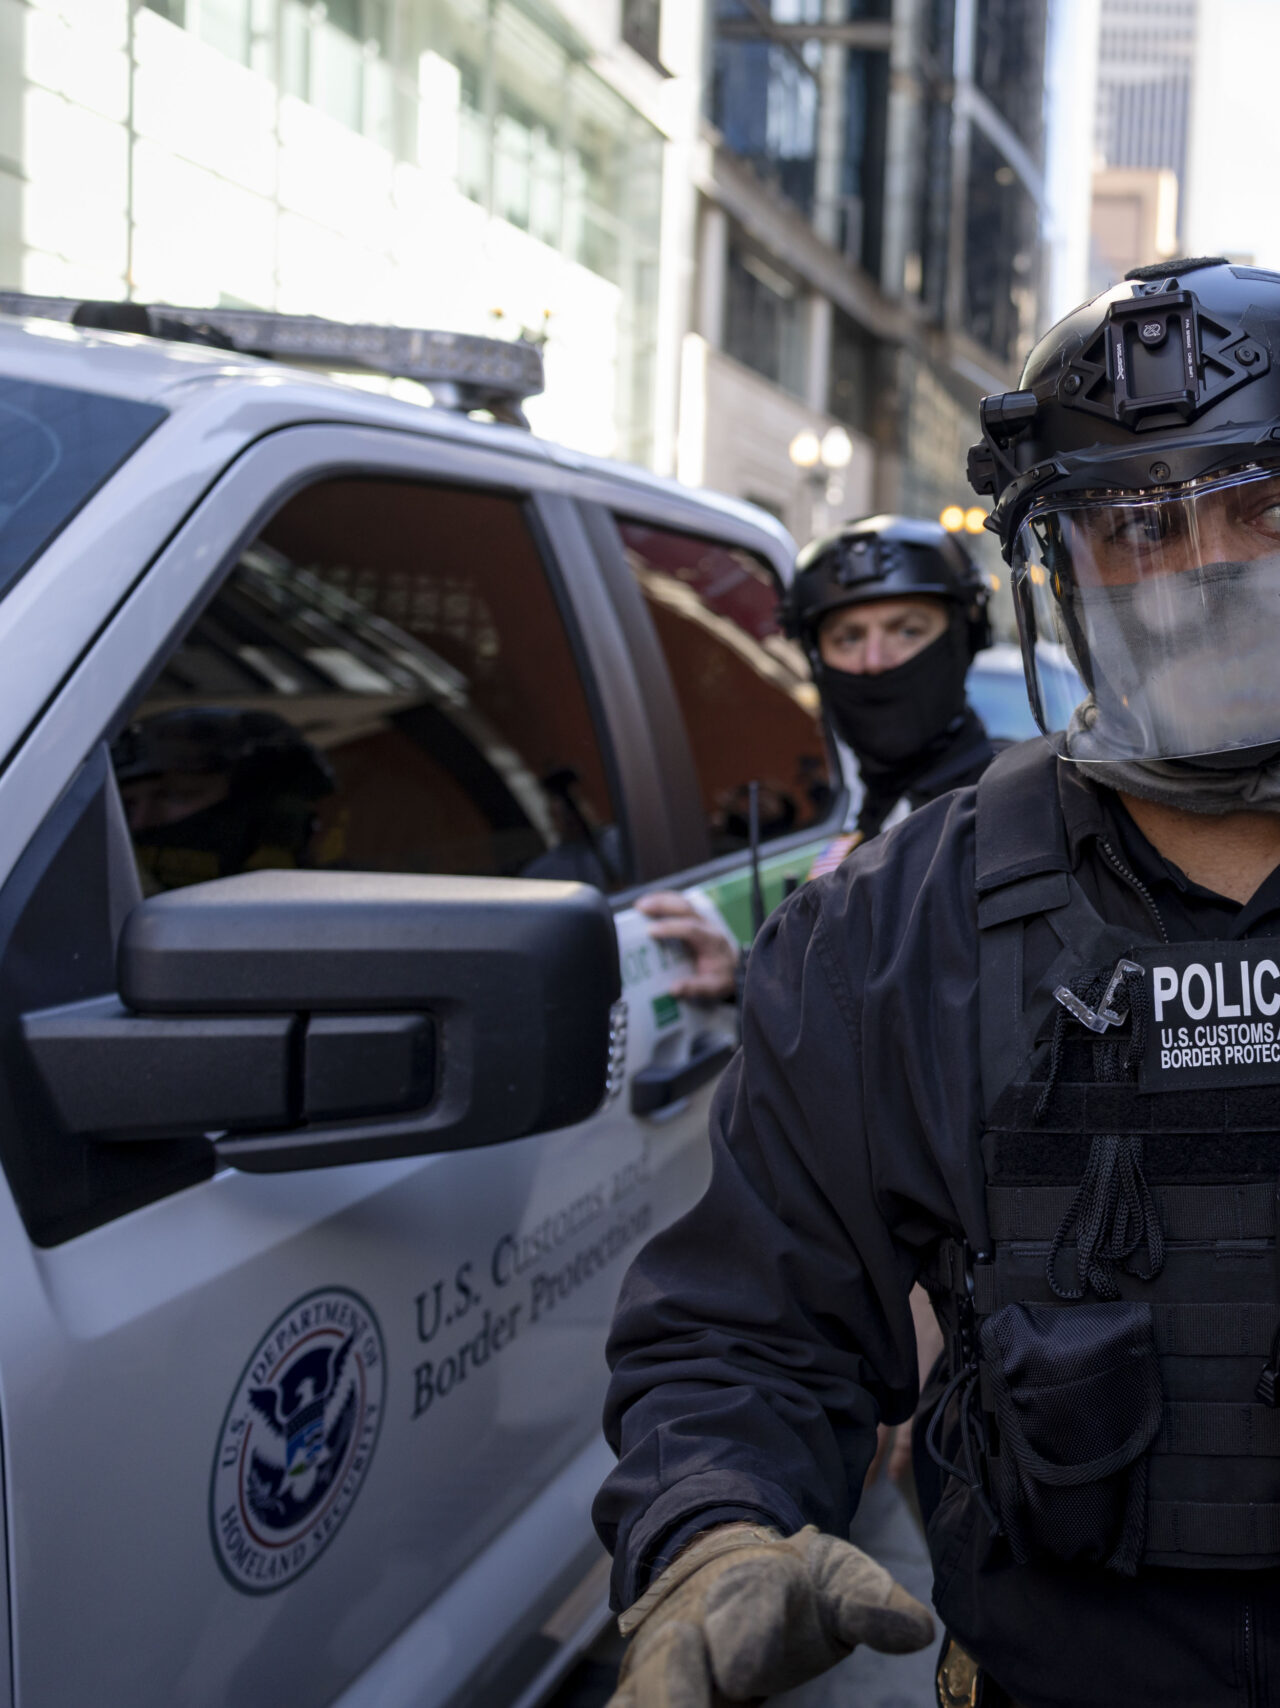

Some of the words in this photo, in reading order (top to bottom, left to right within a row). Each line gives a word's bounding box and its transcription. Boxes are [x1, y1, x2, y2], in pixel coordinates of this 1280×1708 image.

[1161, 1027, 1193, 1048] U.S.
[1194, 1022, 1274, 1047] CUSTOMS
[1161, 1046, 1222, 1069] BORDER
[414, 1260, 481, 1343] U.S.
[222, 1413, 249, 1469] U.S.
[251, 1301, 369, 1385] DEPARTMENT
[411, 1302, 522, 1420] Border
[221, 1504, 307, 1581] HOMELAND
